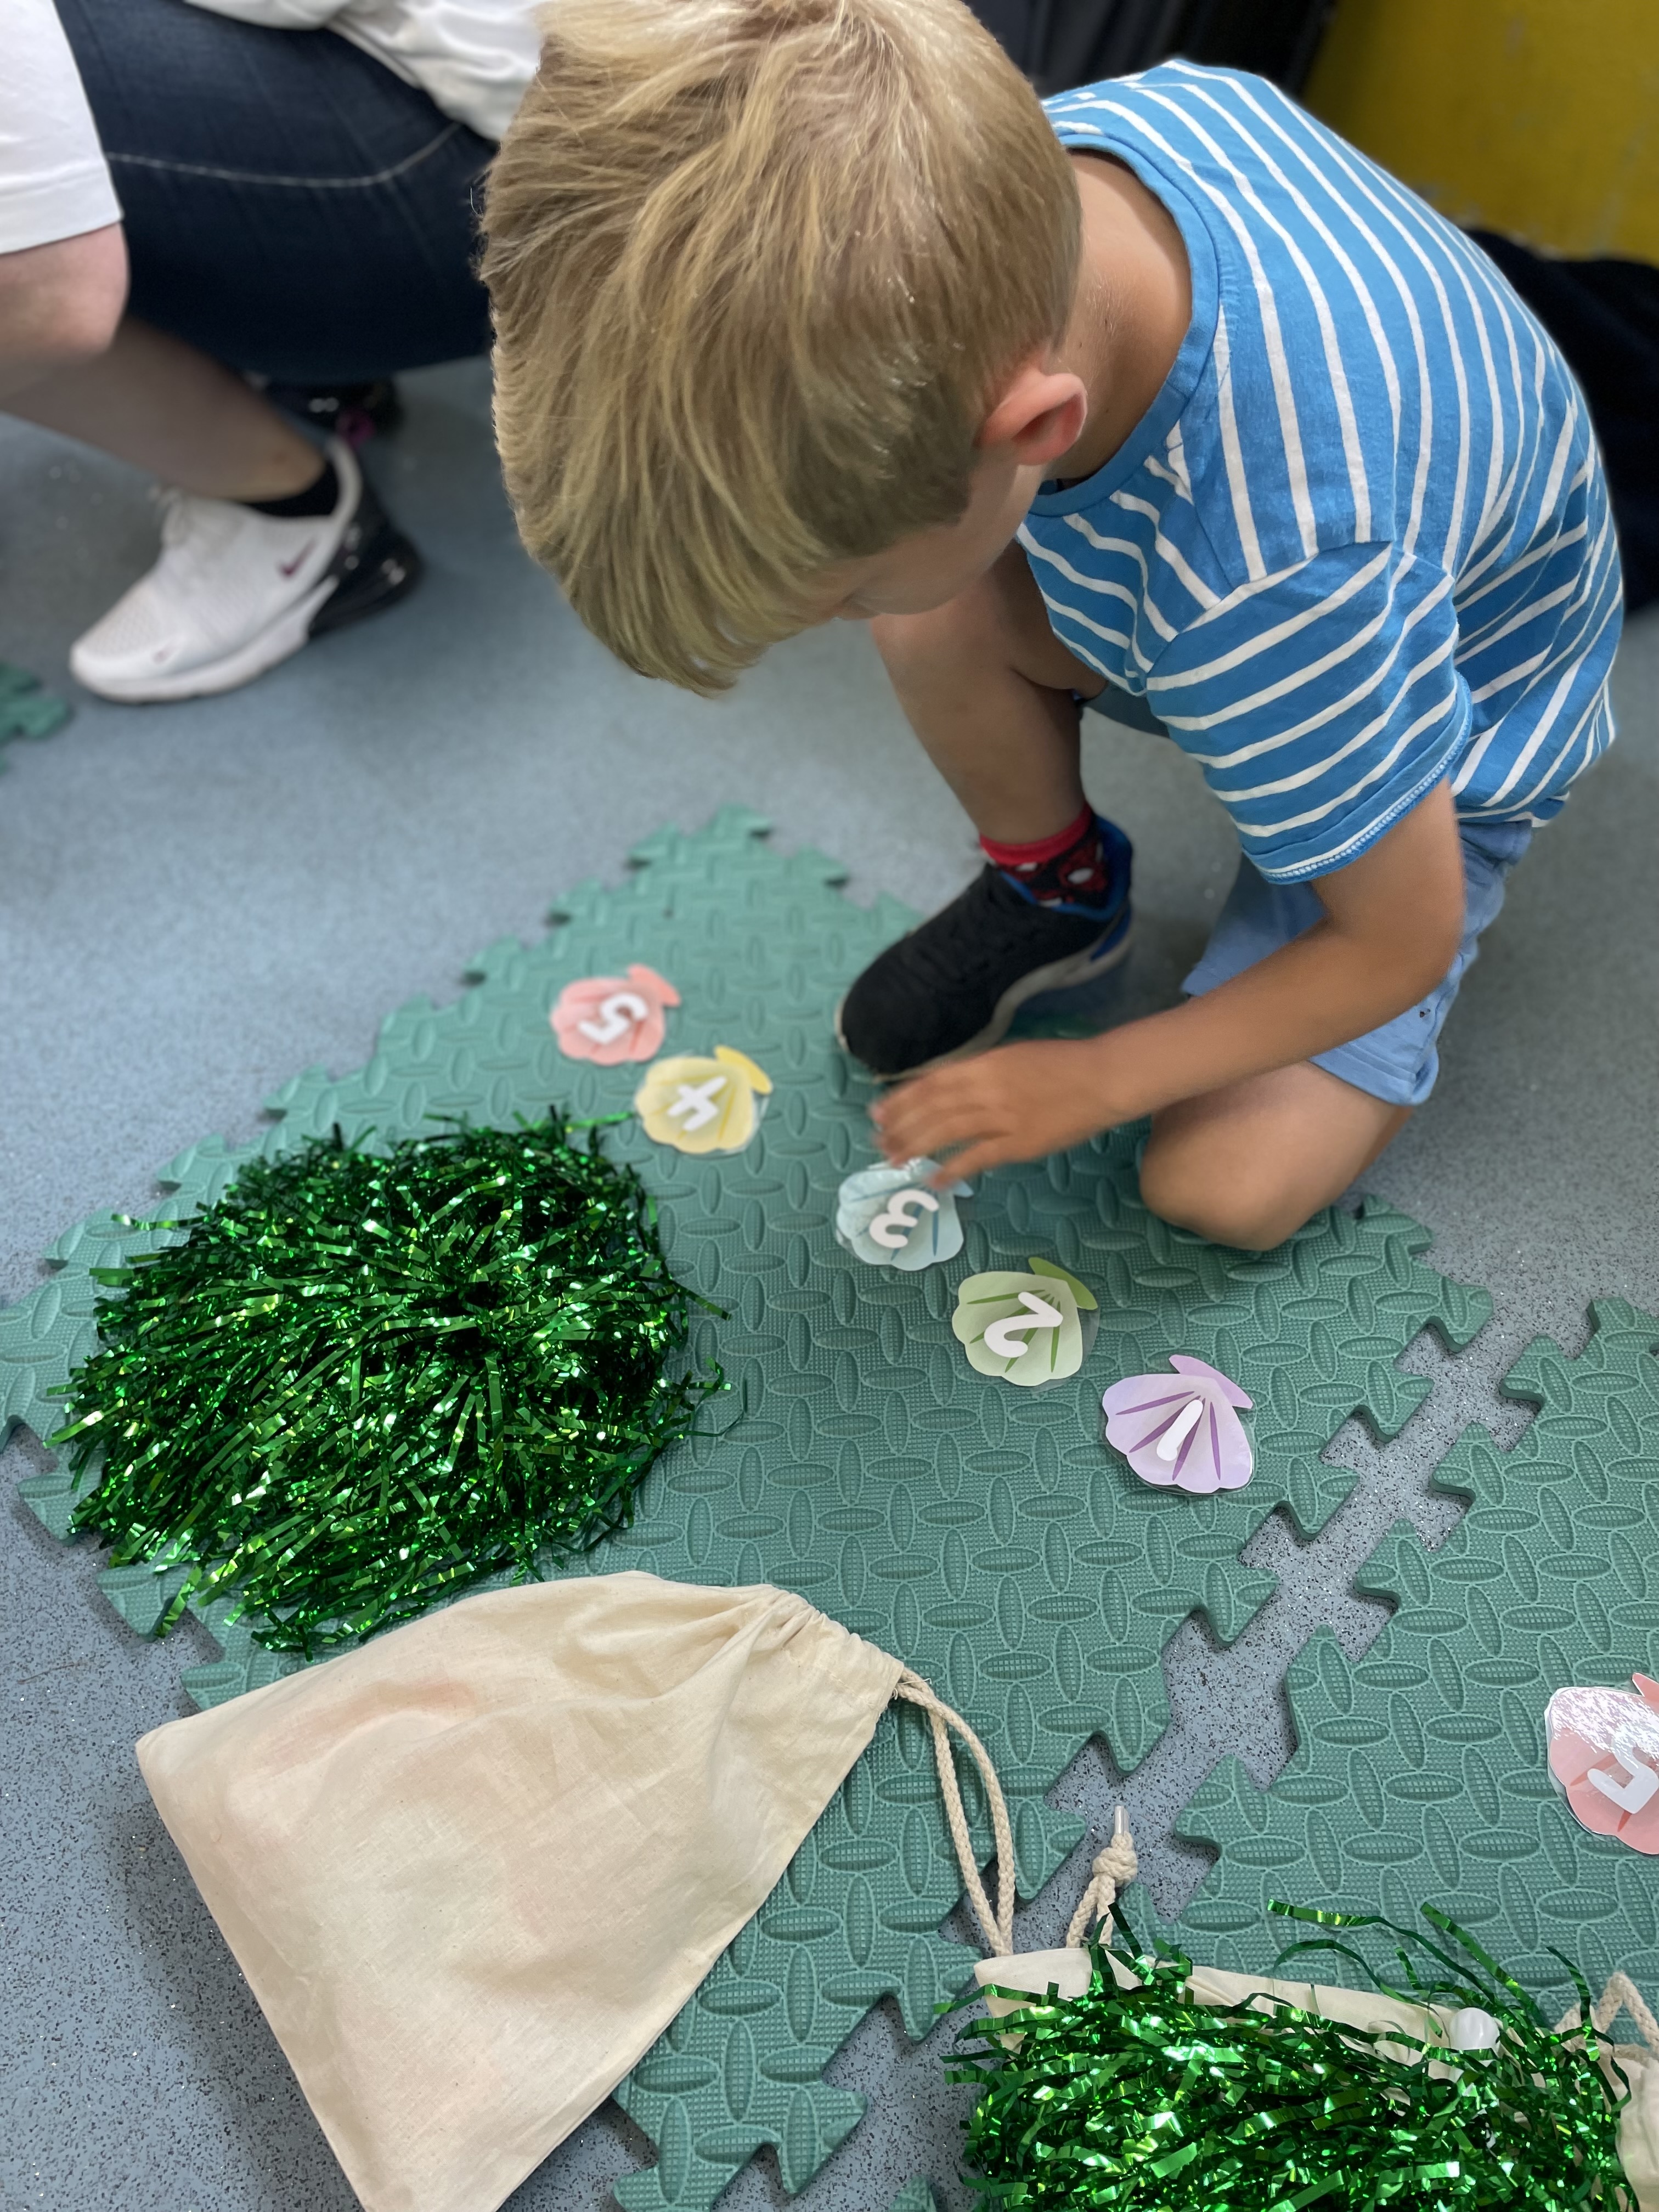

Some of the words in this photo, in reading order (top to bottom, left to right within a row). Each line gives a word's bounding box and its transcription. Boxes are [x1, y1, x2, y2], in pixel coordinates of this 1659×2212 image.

[578, 992, 648, 1043] 5
[667, 1076, 728, 1131] 4
[869, 1189, 939, 1248] 3
[984, 1291, 1064, 1358] 2
[1156, 1400, 1204, 1462] 1
